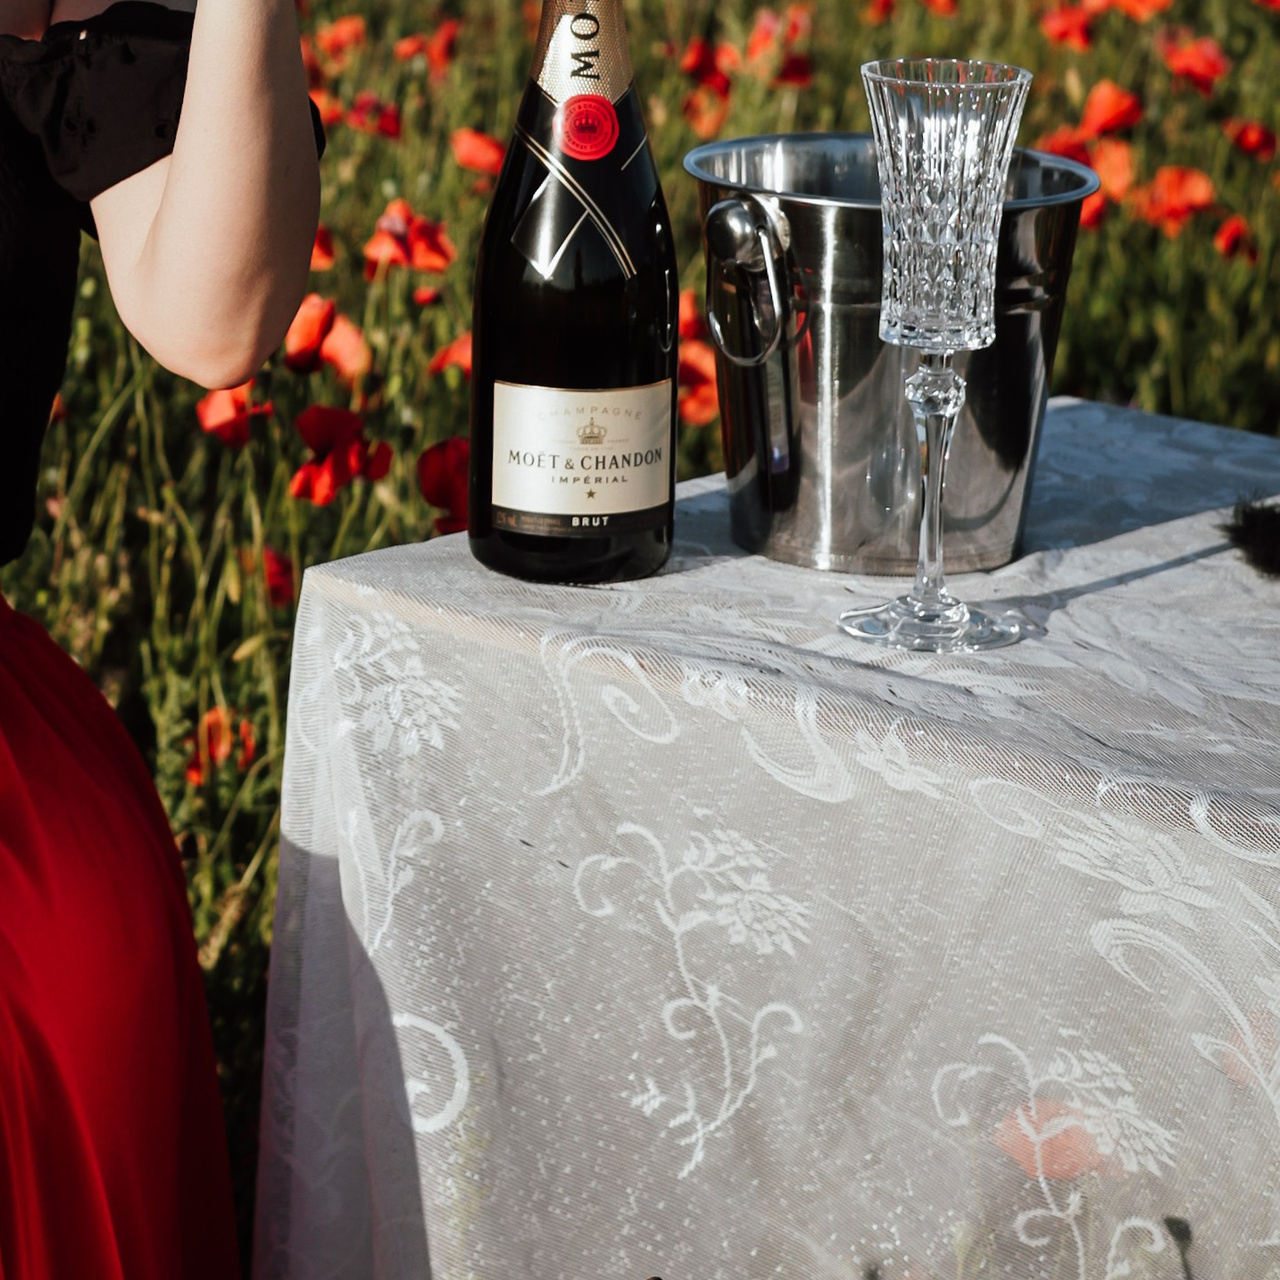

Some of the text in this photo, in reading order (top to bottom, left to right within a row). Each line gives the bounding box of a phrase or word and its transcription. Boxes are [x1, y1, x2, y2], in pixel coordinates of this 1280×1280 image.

[537, 406, 643, 421] CHAMPAGNE
[507, 448, 663, 471] MOËT & CHANDON
[551, 474, 629, 485] IMPÉRIAL
[571, 516, 610, 527] BRUT
